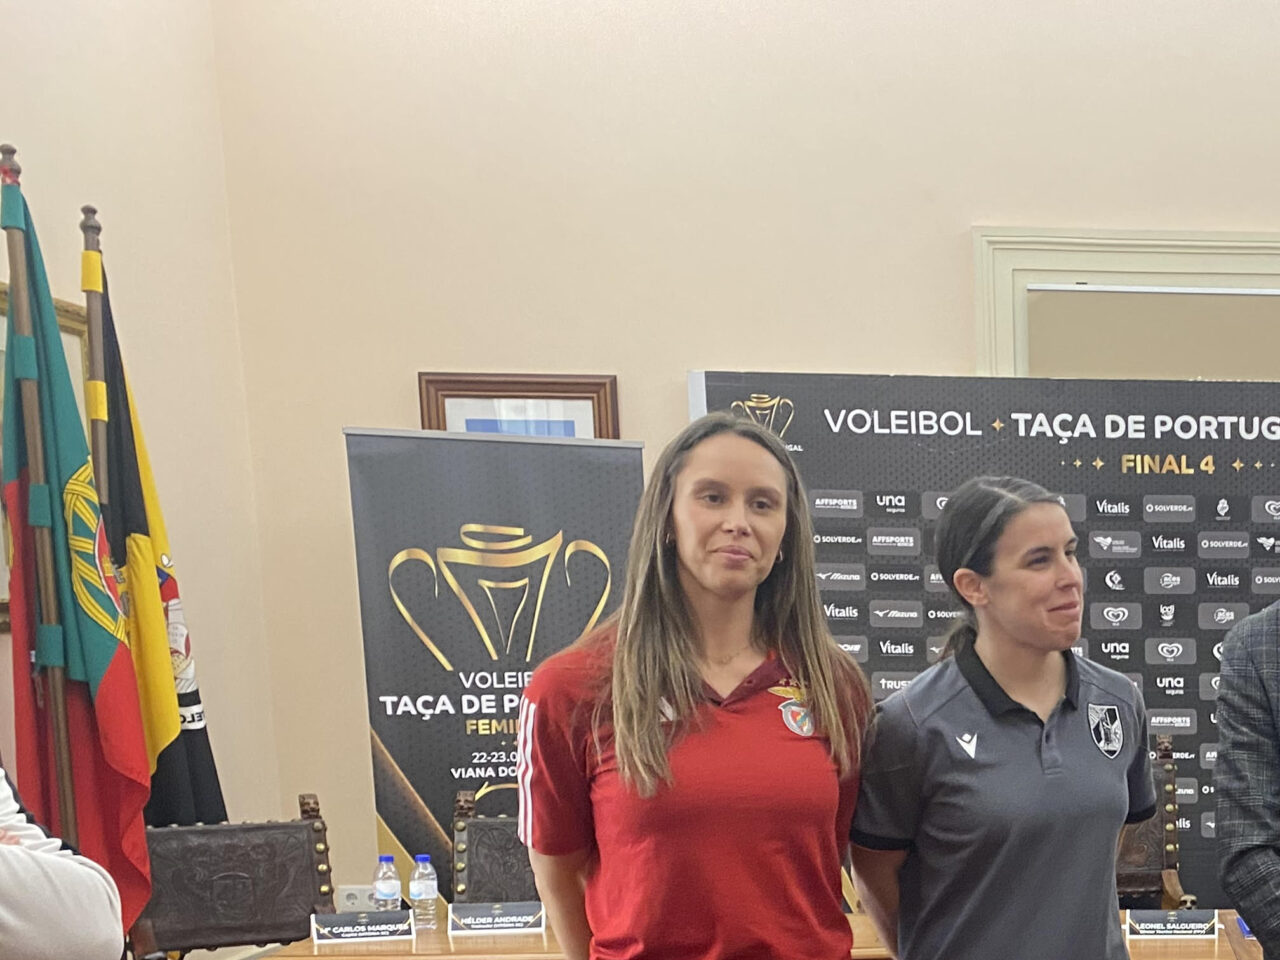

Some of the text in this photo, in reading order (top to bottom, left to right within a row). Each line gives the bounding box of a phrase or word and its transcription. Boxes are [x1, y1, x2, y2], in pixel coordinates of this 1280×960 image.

[824, 409, 983, 436] VOLEIBOL
[1011, 412, 1097, 444] TAÇA
[1105, 415, 1146, 439] DE
[1121, 454, 1216, 475] FINAL 4
[815, 498, 857, 506] AFFSPORTS
[876, 495, 905, 506] una
[1096, 499, 1130, 513] Vitalis
[1152, 535, 1185, 549] Vitalis
[1206, 571, 1239, 585] Vitalis
[824, 603, 858, 617] Vitalis
[880, 640, 914, 654] Vitalis
[1101, 642, 1129, 653] una
[459, 671, 533, 689] VOLEI
[1156, 677, 1184, 688] una
[379, 694, 455, 720] TAÇA
[461, 694, 496, 714] DE
[465, 718, 519, 735] FEMI
[451, 766, 495, 779] VIANA
[494, 915, 534, 923] ANDRADE
[332, 925, 367, 934] CARLOS
[367, 923, 409, 932] MARQUES
